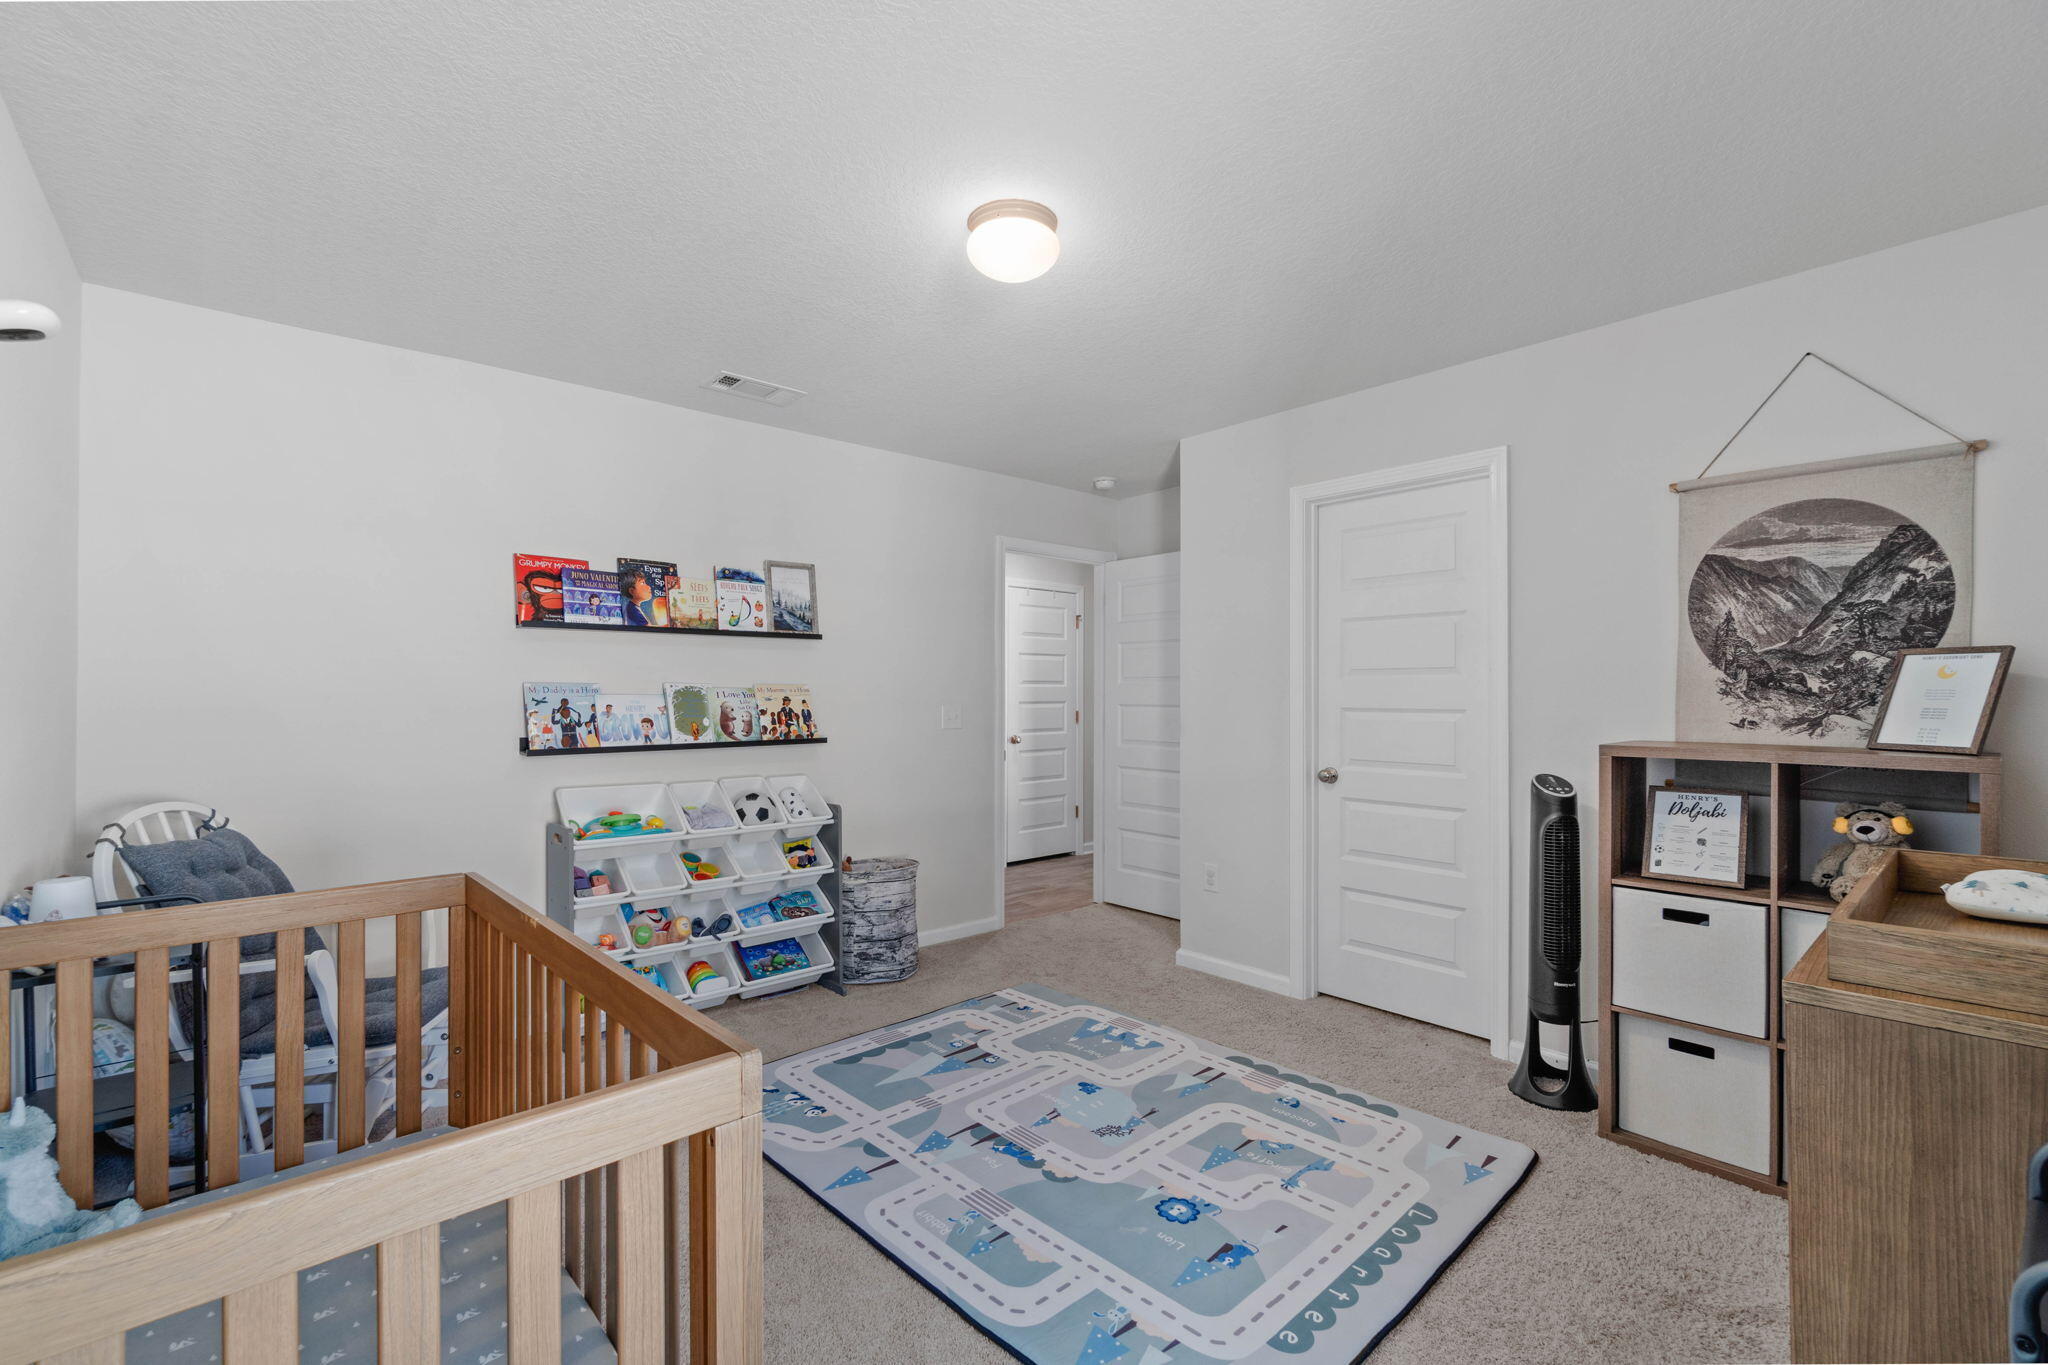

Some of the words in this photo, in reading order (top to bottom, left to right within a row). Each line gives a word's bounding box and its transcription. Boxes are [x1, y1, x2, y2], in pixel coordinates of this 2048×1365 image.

[518, 559, 552, 569] GRUMPY
[553, 562, 586, 570] MONKEY
[645, 565, 662, 574] Eyes
[571, 570, 589, 580] JUNO
[716, 691, 720, 699] I
[741, 691, 756, 699] You
[1677, 794, 1719, 802] HENRY'S
[1667, 801, 1728, 822] Doljabi
[1271, 1106, 1317, 1127] Raccoon
[1246, 1151, 1292, 1174] Giraffe
[916, 1209, 953, 1235] Rabbit
[1156, 1231, 1186, 1251] Lion
[1279, 1208, 1433, 1345] Loartee
